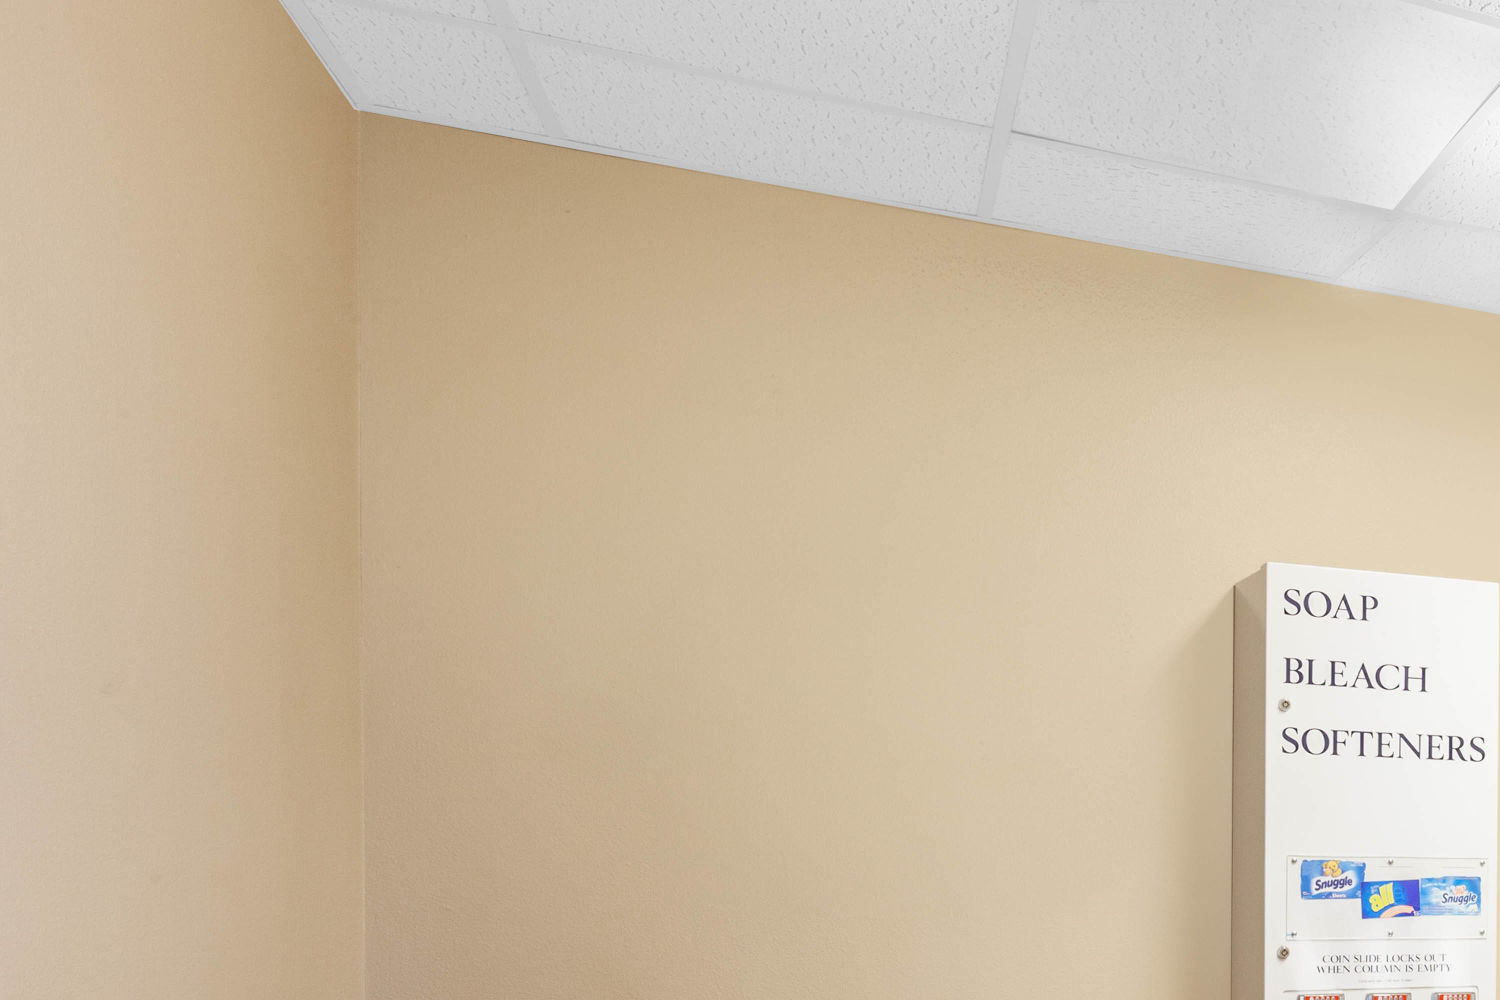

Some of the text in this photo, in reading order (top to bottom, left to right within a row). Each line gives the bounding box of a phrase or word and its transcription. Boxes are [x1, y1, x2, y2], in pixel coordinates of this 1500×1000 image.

[1283, 588, 1379, 621] SOAP
[1283, 656, 1429, 693] BLEACH
[1281, 726, 1486, 763] SOFTENERS
[1314, 875, 1353, 891] Snuggle
[1368, 882, 1395, 913] all
[1441, 892, 1478, 905] Snuggle
[1316, 963, 1451, 974] WHEN COLUMN IS EMPTY
[1322, 953, 1447, 963] COIN SLIDE LOCKS OUT
